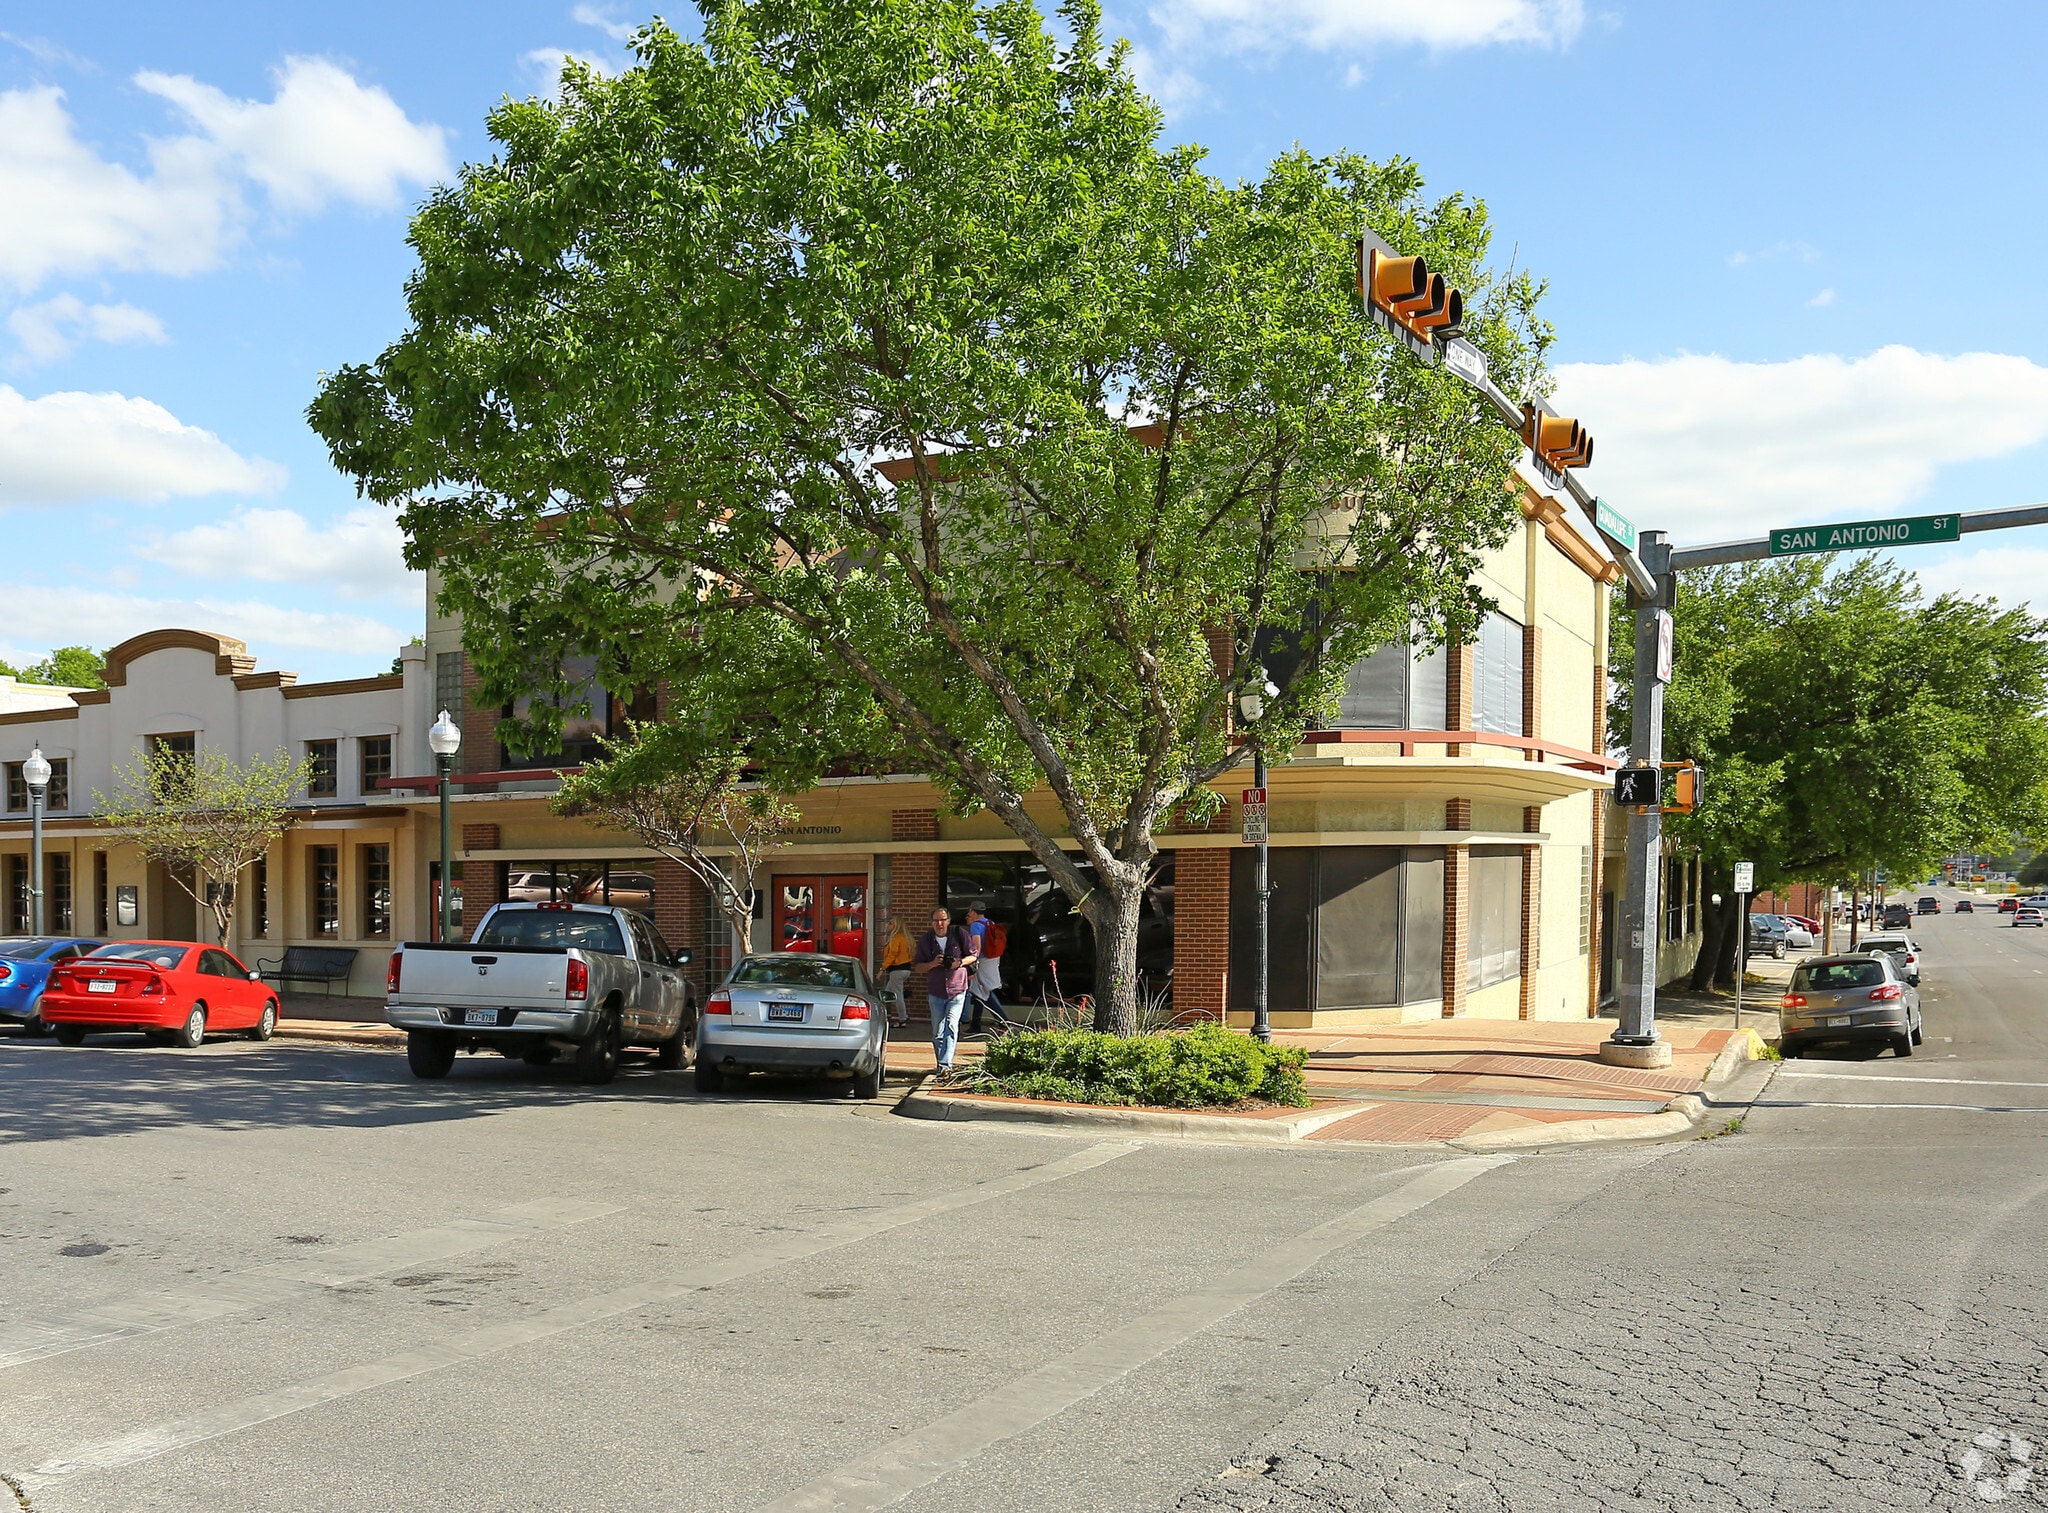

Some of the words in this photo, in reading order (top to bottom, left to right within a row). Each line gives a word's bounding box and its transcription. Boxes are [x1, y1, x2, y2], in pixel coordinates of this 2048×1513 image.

[1779, 531, 1817, 550] SAN
[1828, 523, 1910, 545] ANTONIO
[1933, 517, 1950, 530] ST
[1248, 790, 1260, 803] NO
[775, 827, 793, 835] SAN
[797, 826, 841, 834] ANTONIO
